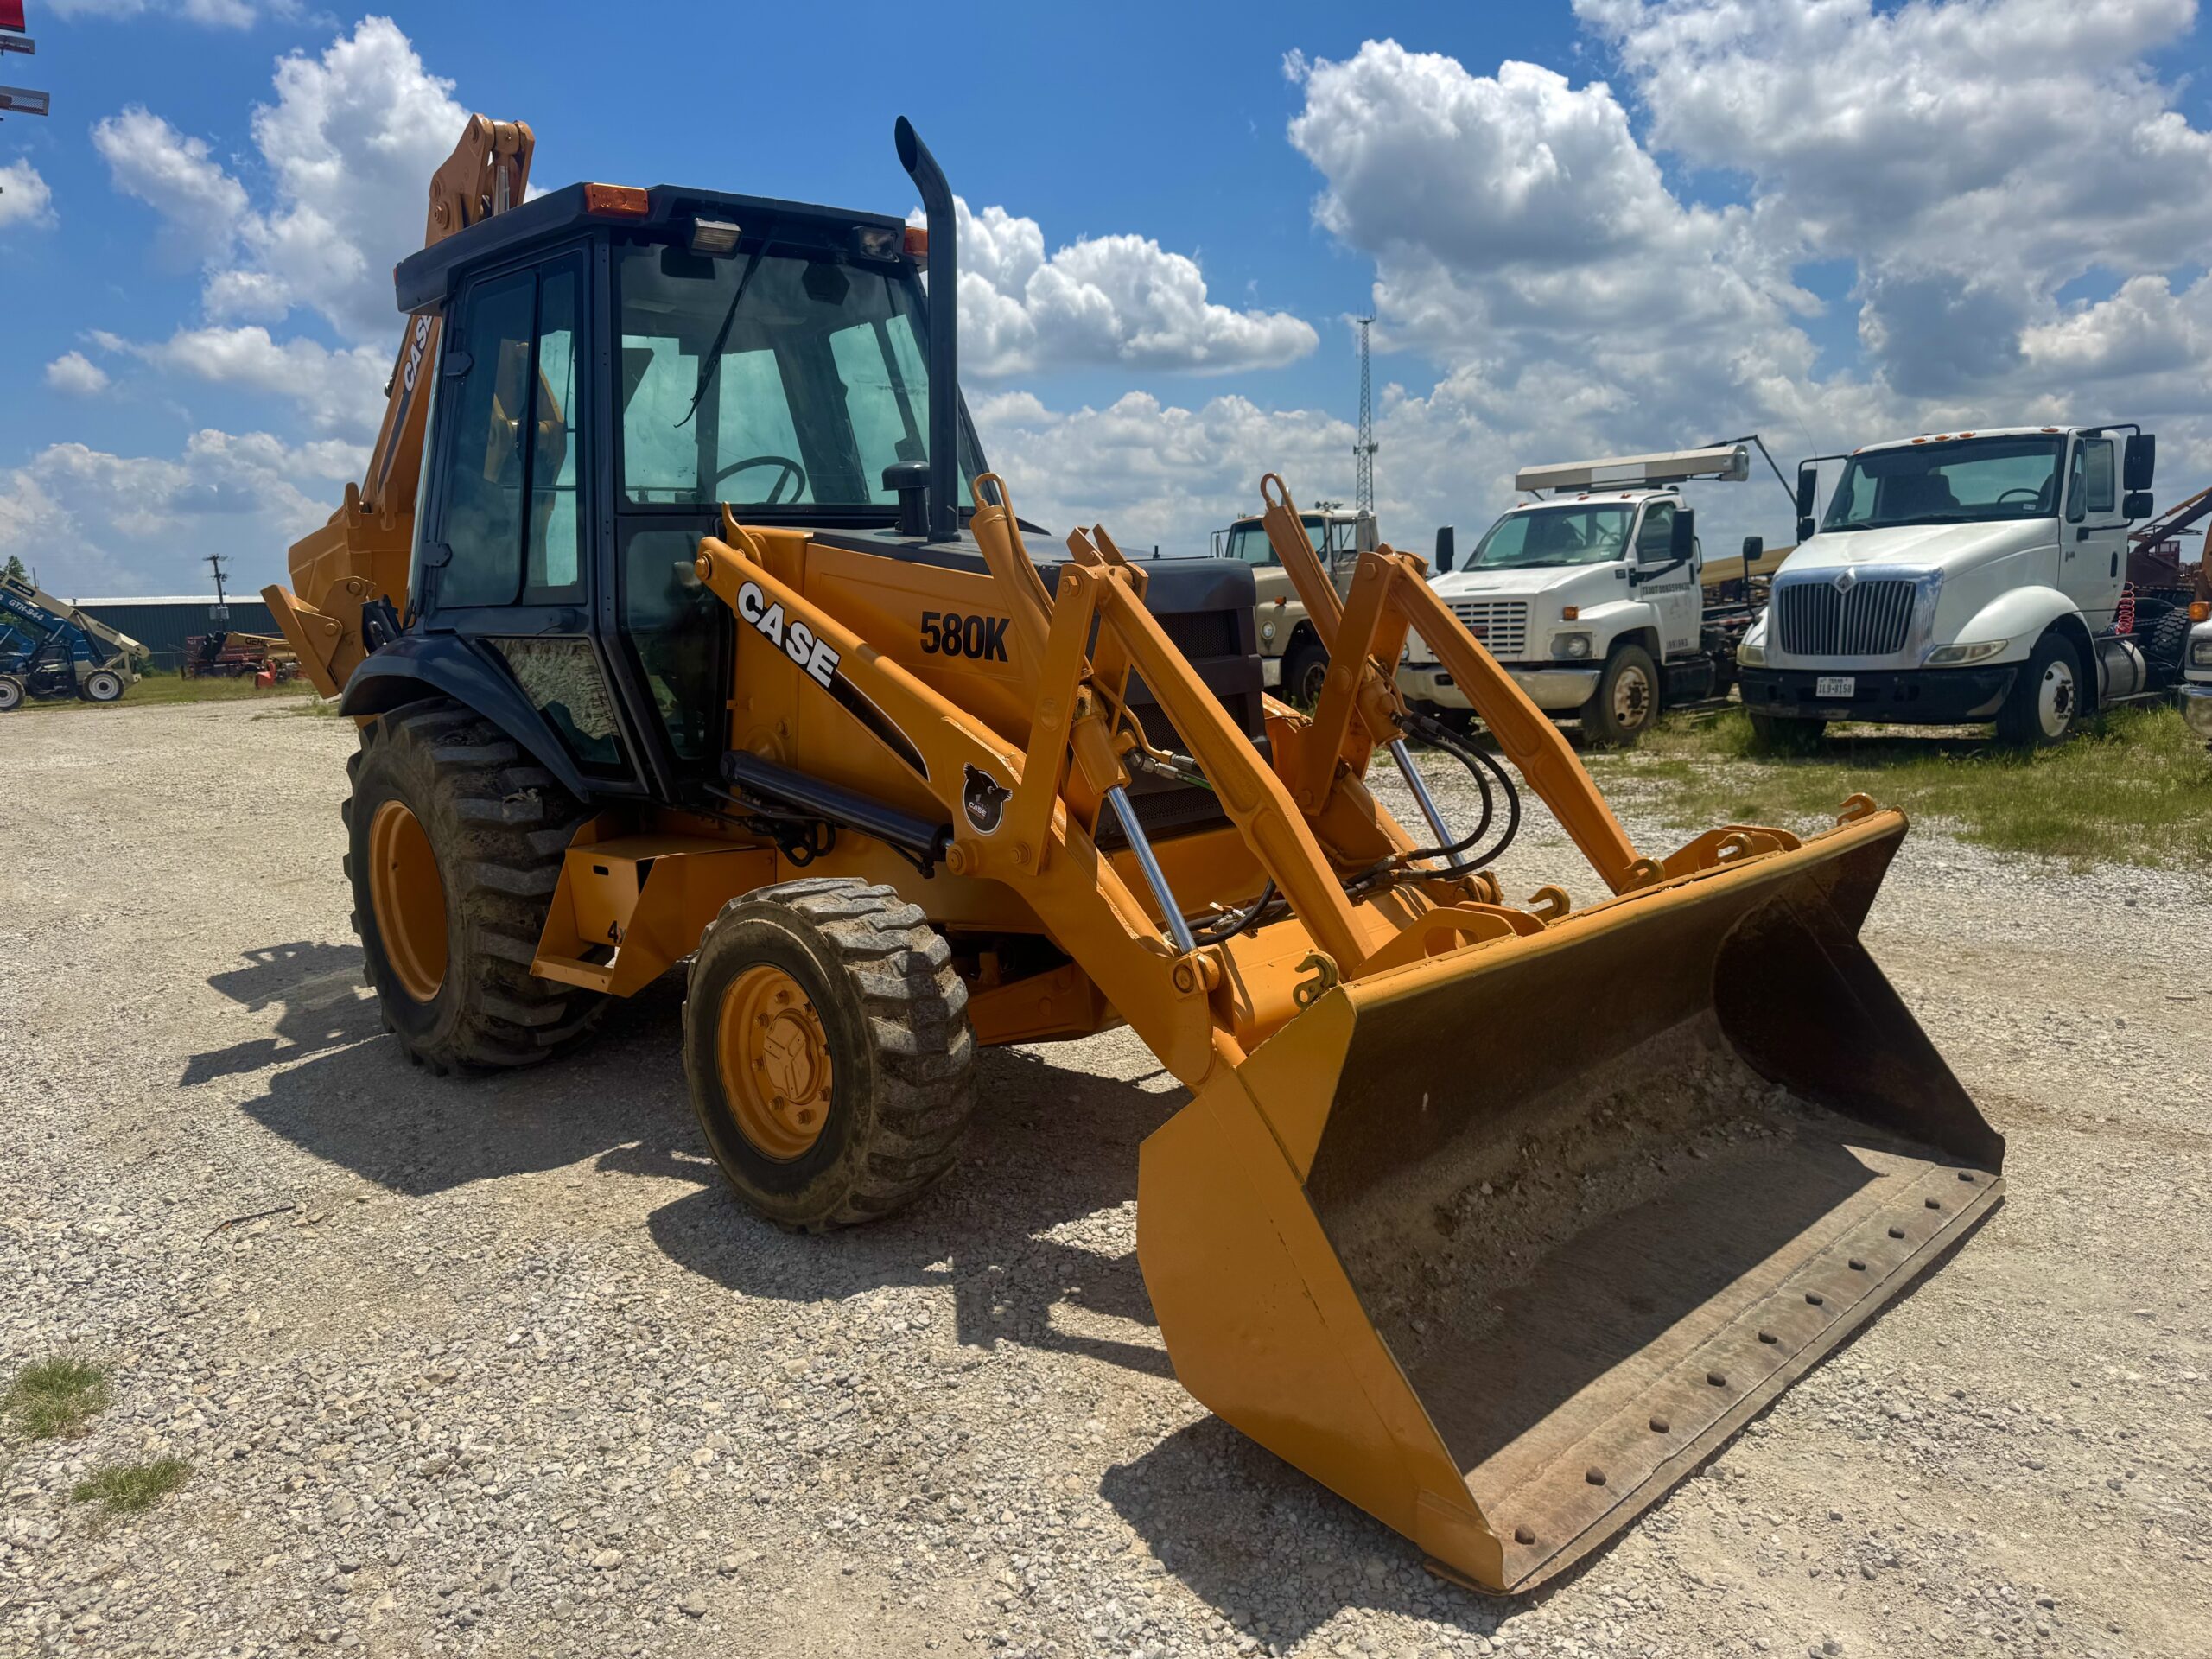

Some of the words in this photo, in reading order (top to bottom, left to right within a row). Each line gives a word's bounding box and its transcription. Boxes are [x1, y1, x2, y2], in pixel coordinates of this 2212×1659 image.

[8, 599, 45, 621] GTH-844
[245, 637, 264, 645] GEH
[737, 582, 840, 688] CASE
[920, 611, 1010, 663] 580K
[969, 802, 987, 817] CASE
